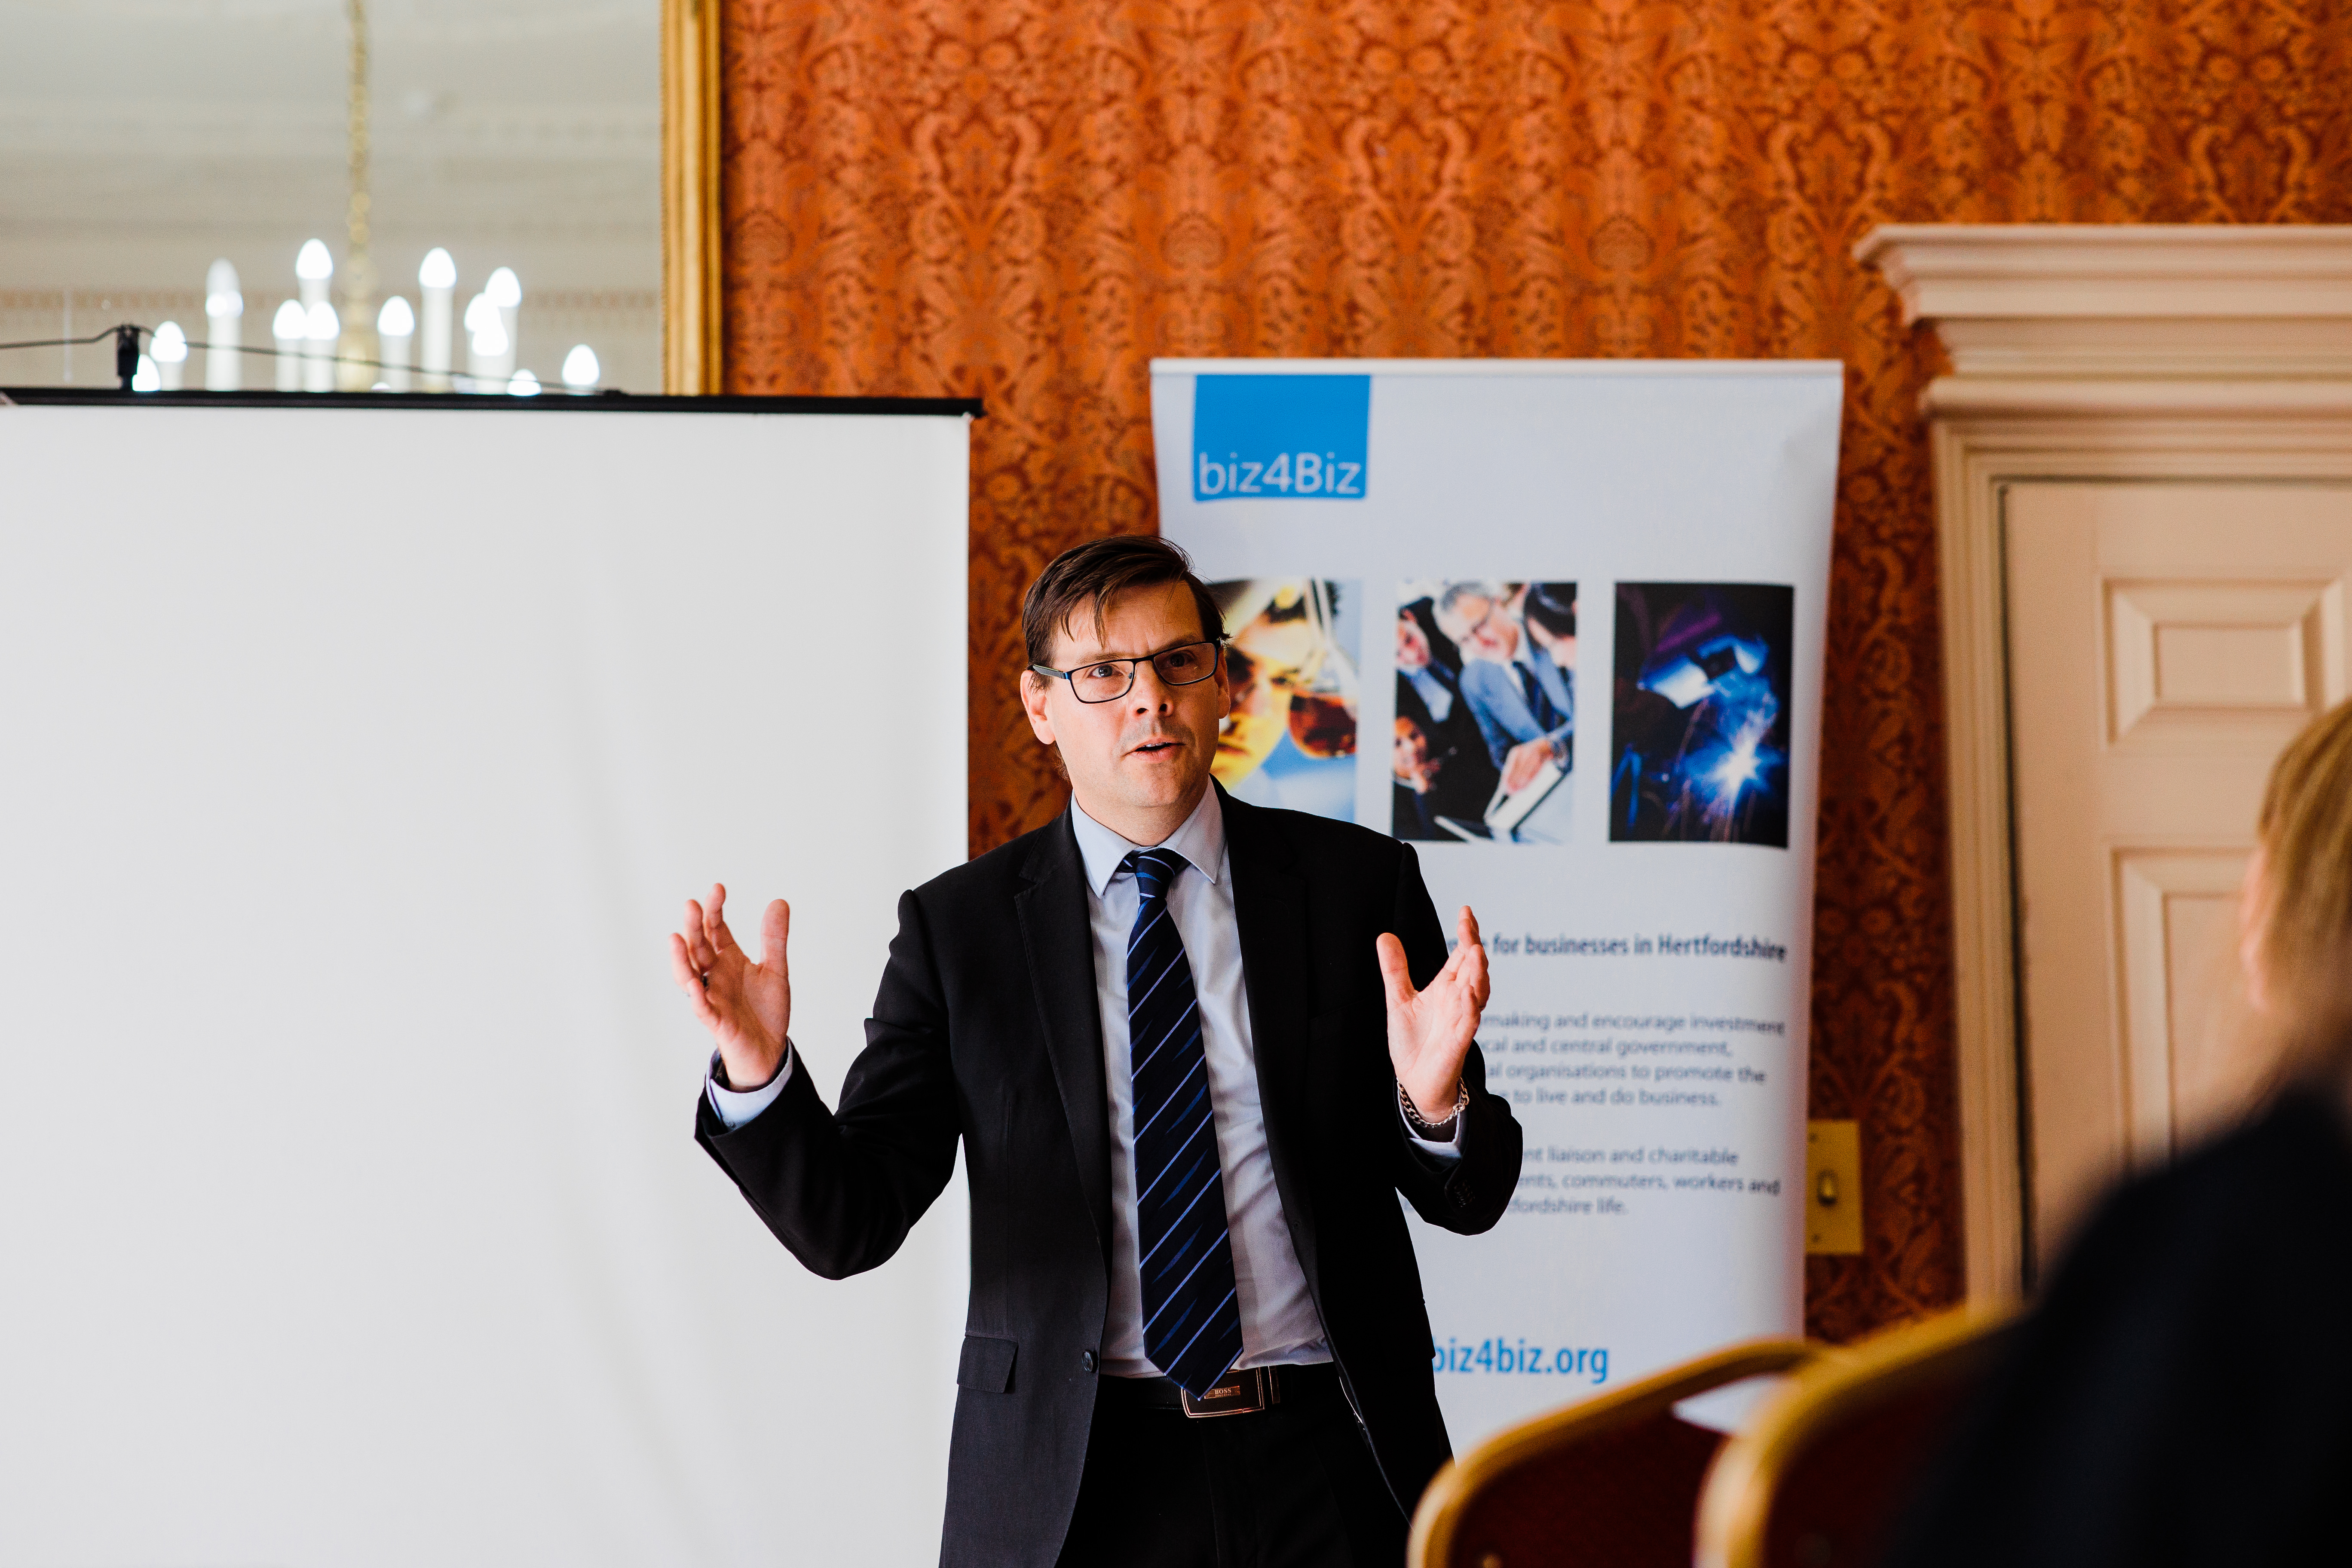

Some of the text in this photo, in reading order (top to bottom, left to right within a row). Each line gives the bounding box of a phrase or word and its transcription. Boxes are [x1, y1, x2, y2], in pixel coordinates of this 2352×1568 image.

[1199, 451, 1361, 495] biz4Biz
[1493, 932, 1519, 956] for
[1525, 931, 1629, 957] businesses
[1634, 933, 1653, 956] in
[1658, 932, 1786, 963] Hertfordshire
[1554, 1011, 1589, 1029] and
[1592, 1014, 1685, 1034] encourage
[1690, 1013, 1785, 1037] investment
[1511, 1036, 1547, 1054] and
[1550, 1036, 1613, 1054] central
[1615, 1040, 1733, 1059] government,
[1505, 1061, 1626, 1084] organisations
[1631, 1064, 1651, 1081] to
[1655, 1065, 1733, 1084] promote
[1738, 1065, 1766, 1084] the
[1513, 1089, 1533, 1105] to
[1535, 1085, 1568, 1106] live
[1571, 1087, 1607, 1106] and
[1610, 1086, 1635, 1106] do
[1638, 1088, 1719, 1106] business.
[1547, 1145, 1606, 1164] liaison
[1609, 1145, 1645, 1164] and
[1648, 1145, 1739, 1167] charitable
[1561, 1173, 1669, 1191] commuters,
[1673, 1171, 1744, 1193] workers
[1747, 1177, 1781, 1197] and
[1596, 1194, 1629, 1216] life.
